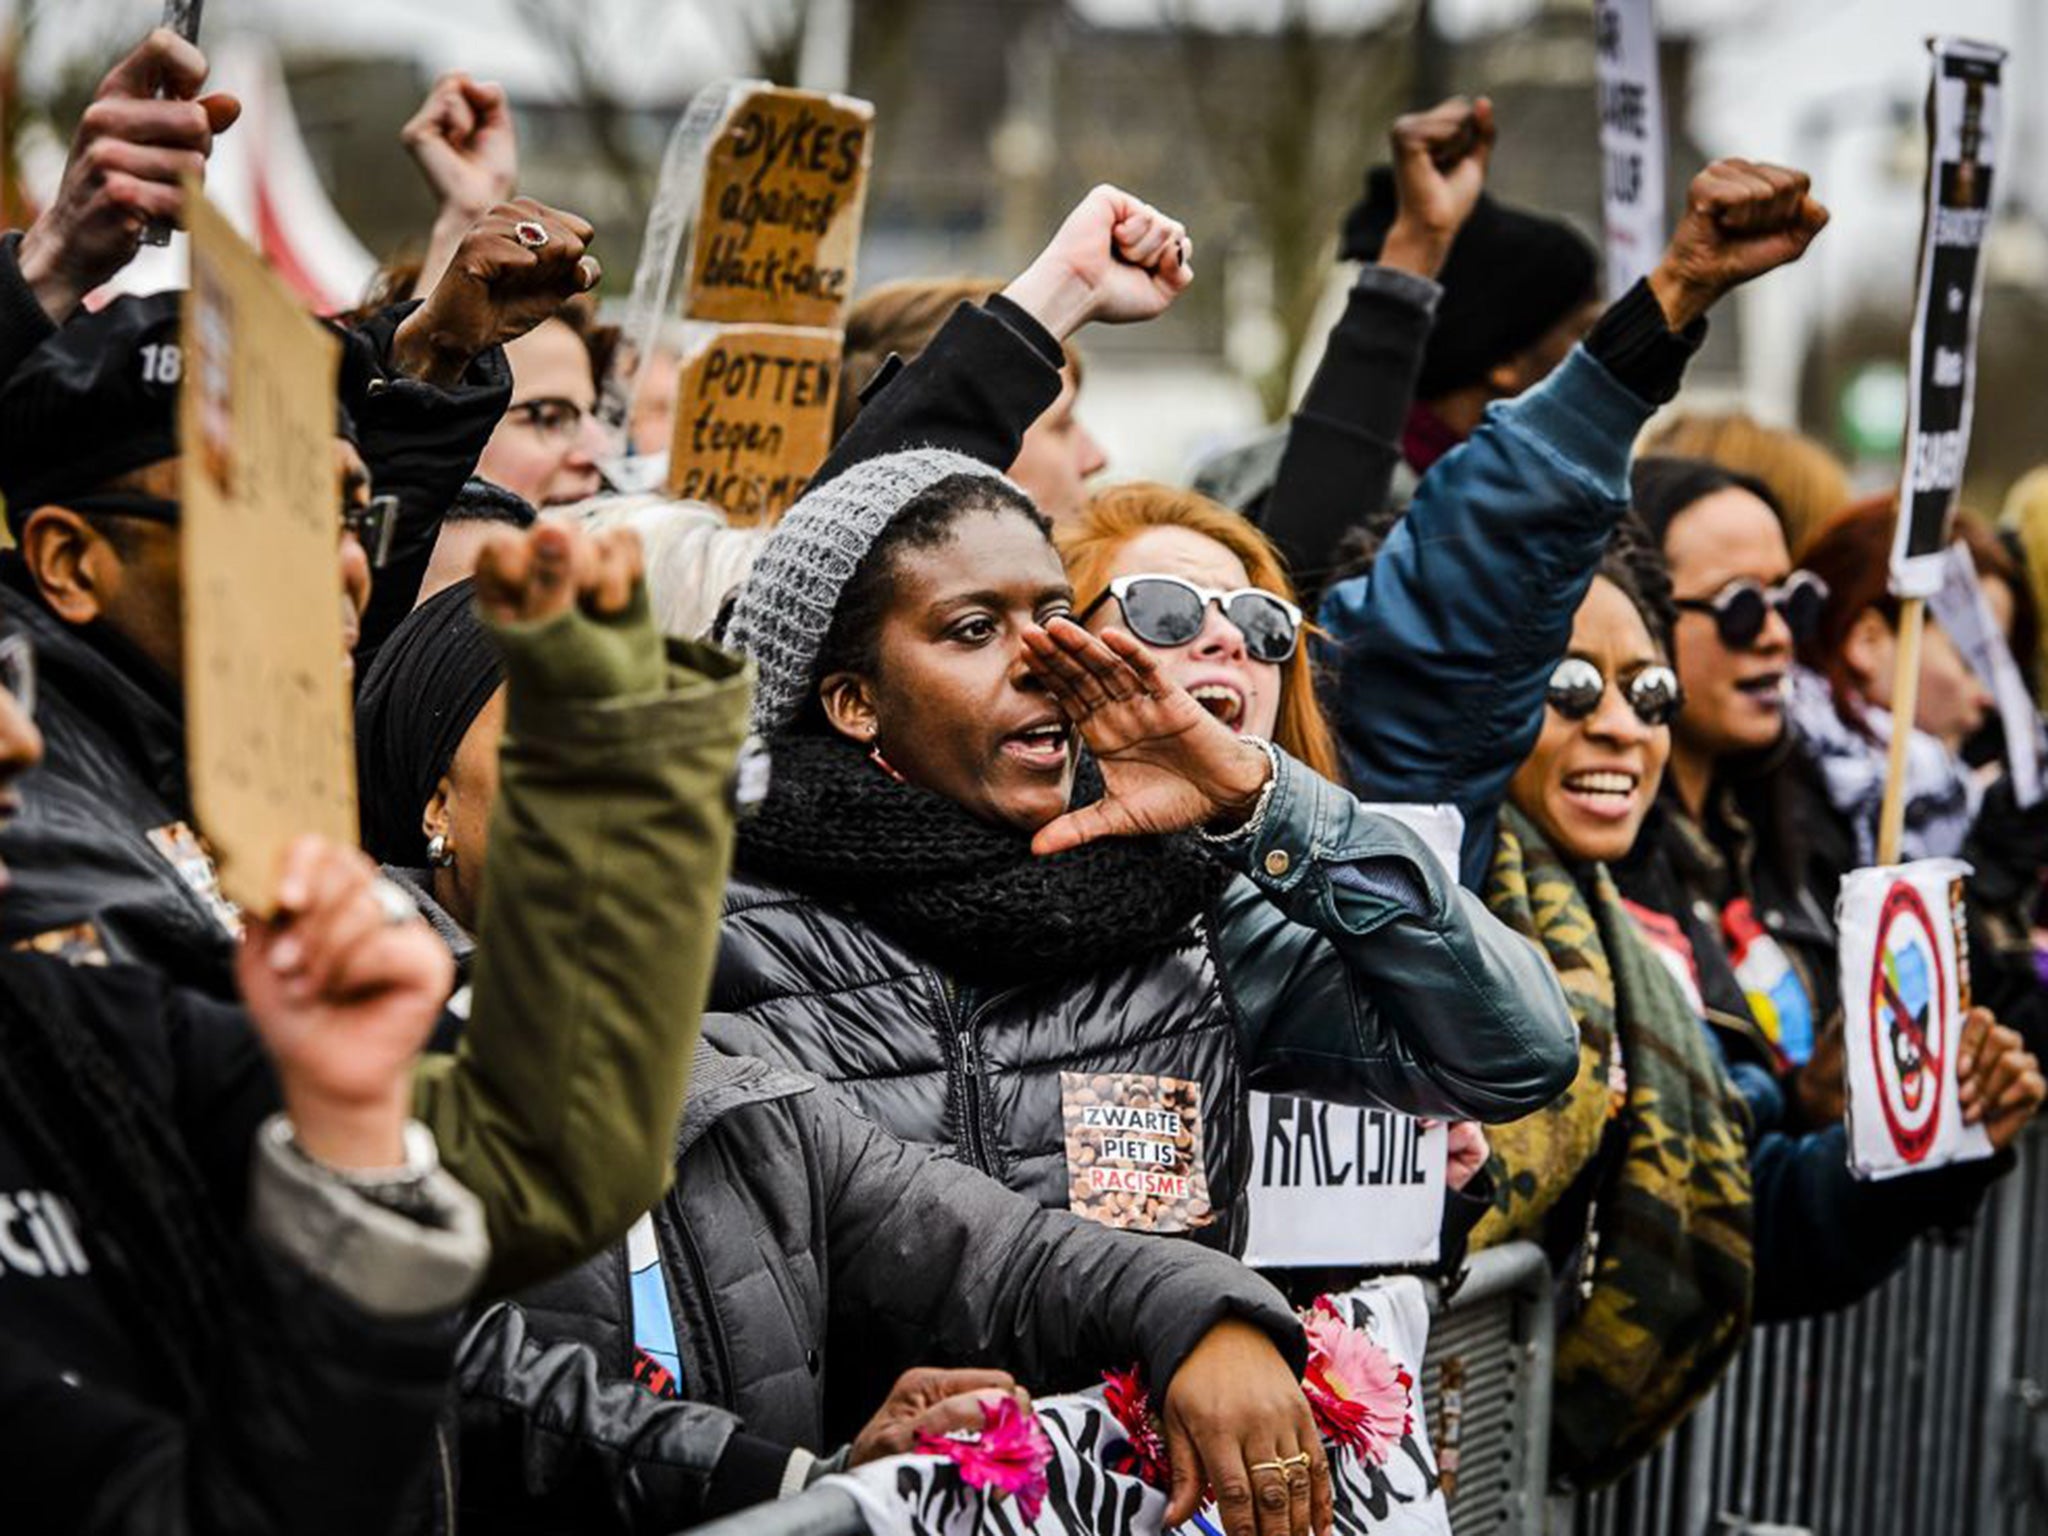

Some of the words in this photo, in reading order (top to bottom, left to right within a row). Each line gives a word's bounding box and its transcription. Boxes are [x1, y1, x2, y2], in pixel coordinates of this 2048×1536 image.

[732, 109, 863, 190] DYKES
[692, 402, 783, 472] tegen
[1086, 1108, 1178, 1133] ZWARTE
[1103, 1139, 1147, 1160] PIET
[1154, 1144, 1172, 1164] IS
[1091, 1169, 1187, 1197] RACISME
[0, 1189, 91, 1278] cil
